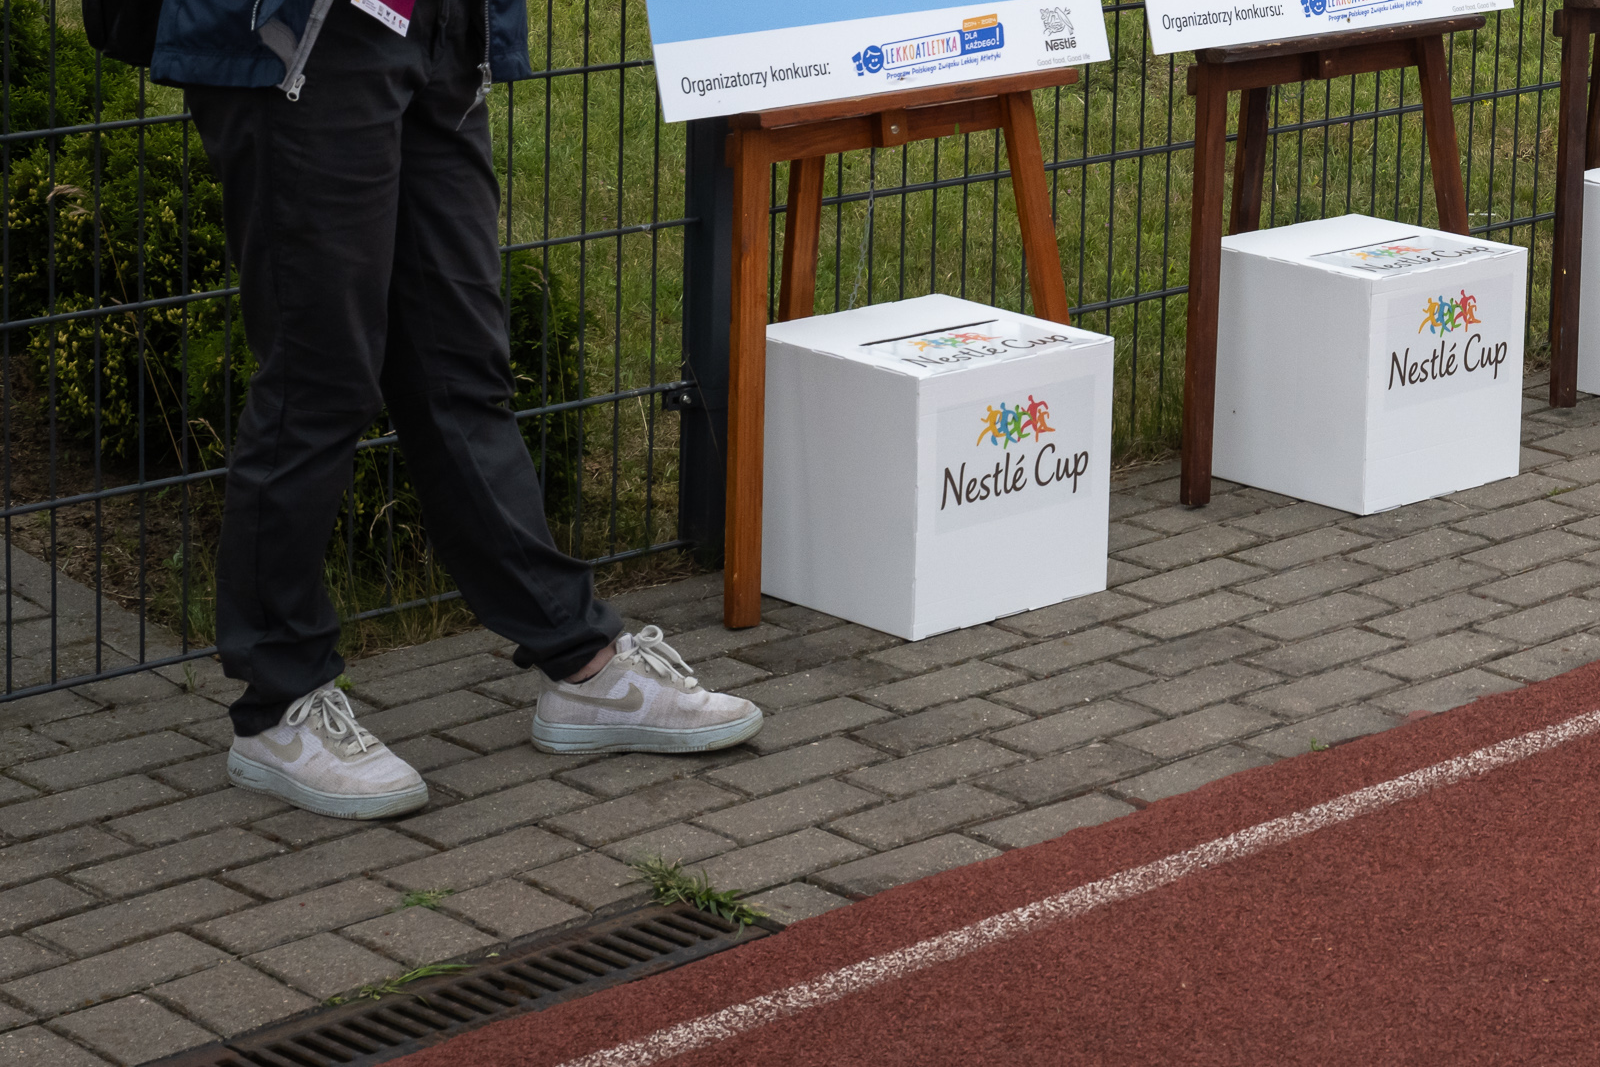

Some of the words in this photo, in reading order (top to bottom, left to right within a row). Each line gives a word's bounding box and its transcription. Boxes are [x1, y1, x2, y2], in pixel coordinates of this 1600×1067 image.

[886, 36, 958, 64] LEKKOATLETYKA
[965, 32, 978, 40] DLA
[1045, 36, 1077, 52] Nestlé
[681, 67, 768, 97] Organizatorzy
[771, 61, 831, 82] konkursu:
[887, 71, 910, 80] Program
[912, 66, 936, 76] Polskiego
[938, 61, 959, 71] Związku
[961, 57, 979, 67] Lekkiej
[980, 53, 1001, 63] Atletyki
[901, 346, 1007, 367] Nestlé
[1006, 334, 1072, 349] Cup
[1388, 340, 1458, 390] Nestlé
[1464, 334, 1507, 379] Cup
[940, 452, 1027, 511] Nestlé
[1034, 443, 1089, 493] Cup
